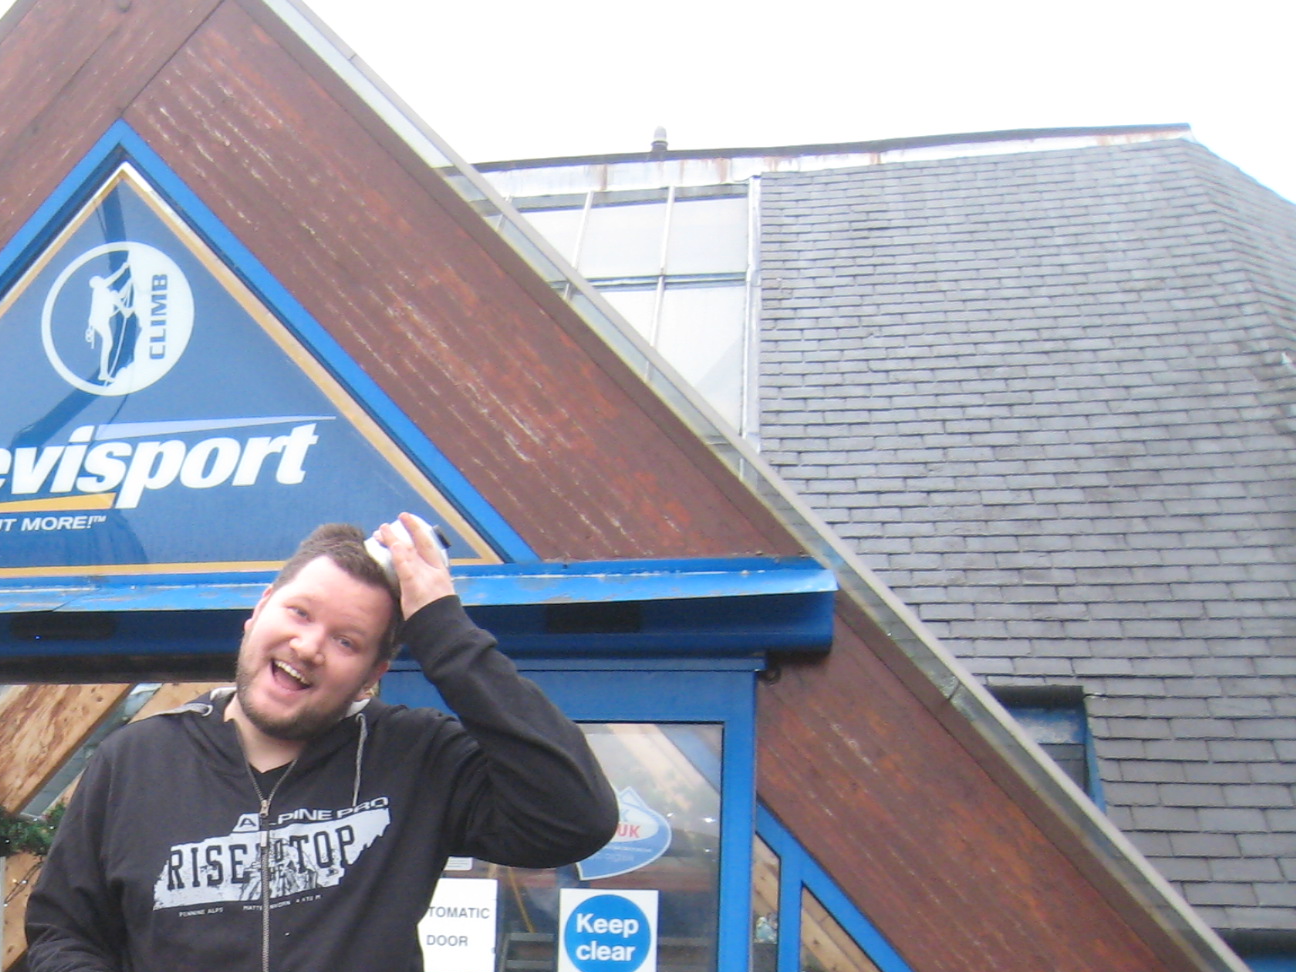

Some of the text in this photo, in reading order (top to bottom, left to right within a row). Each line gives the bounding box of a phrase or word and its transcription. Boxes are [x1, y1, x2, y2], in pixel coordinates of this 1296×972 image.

[149, 274, 168, 360] CLIMB
[337, 796, 389, 818] PRO
[166, 843, 248, 890] RISE
[289, 825, 356, 874] TOP
[428, 906, 490, 919] TOMATIC
[576, 913, 639, 938] Keep
[426, 934, 469, 947] DOOR
[575, 940, 636, 961] clear
